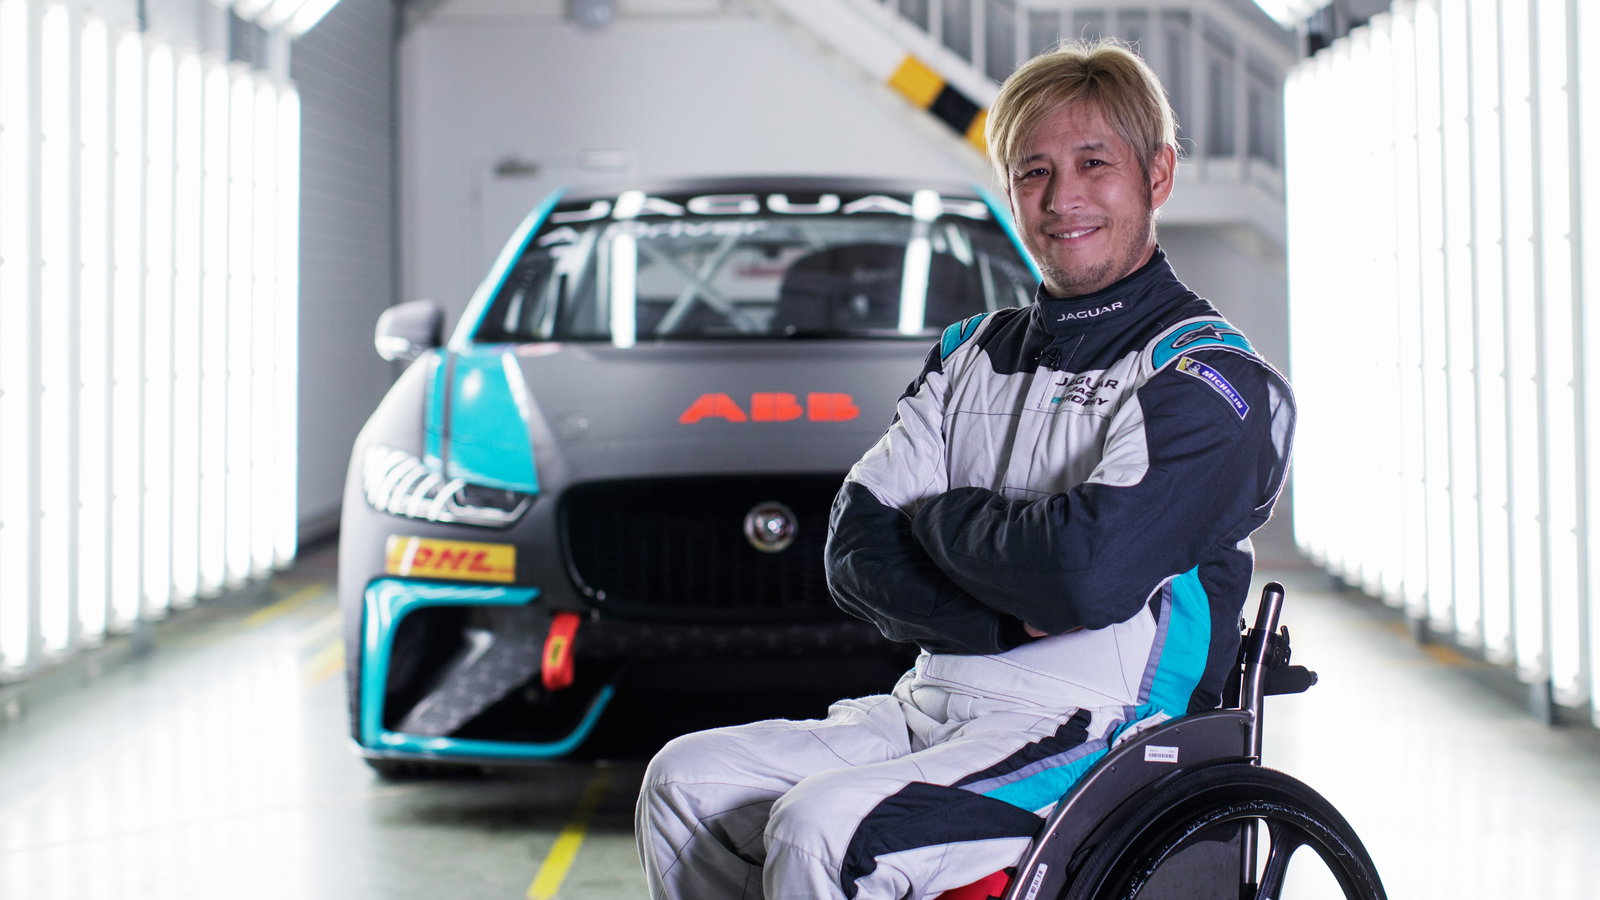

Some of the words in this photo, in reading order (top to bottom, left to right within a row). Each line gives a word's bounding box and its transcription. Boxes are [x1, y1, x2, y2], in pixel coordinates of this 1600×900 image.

[1056, 301, 1124, 322] JAGUAR
[1201, 370, 1244, 409] MICHELIN
[678, 392, 860, 424] ABB
[411, 546, 493, 572] DHL
